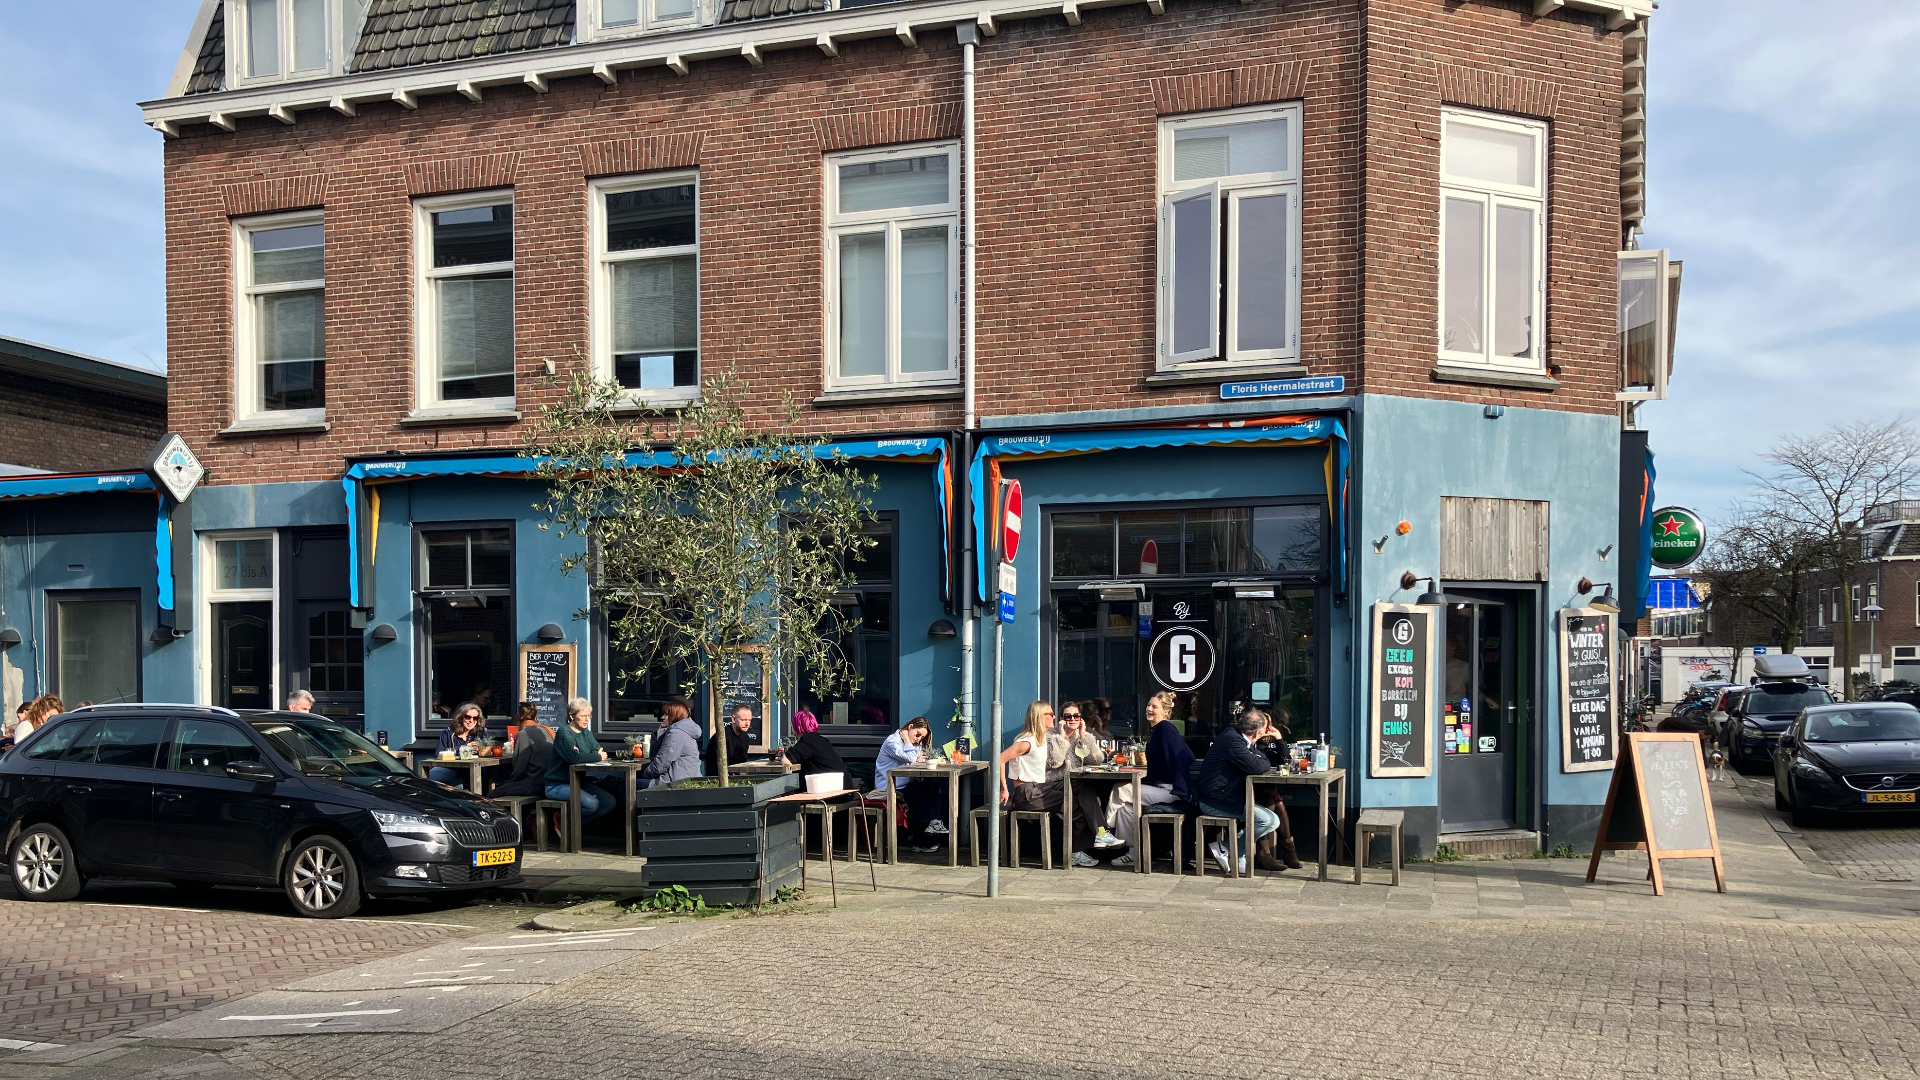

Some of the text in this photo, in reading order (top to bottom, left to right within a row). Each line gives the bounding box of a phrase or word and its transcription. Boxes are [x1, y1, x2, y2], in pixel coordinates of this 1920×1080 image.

[1231, 379, 1335, 394] Floris Heermalestraat
[877, 440, 916, 448] BROUWERIJ
[998, 436, 1038, 446] BROUWERIJ
[1652, 538, 1697, 548] eineken
[224, 565, 268, 579] 27 bis A
[1397, 622, 1409, 641] G
[1570, 633, 1604, 648] WINTER
[529, 652, 564, 662] BIER OP TAP
[1169, 634, 1196, 683] G
[1385, 648, 1414, 663] GEEN
[1394, 676, 1414, 689] KOM
[1381, 689, 1418, 702] BORRELEN
[1394, 703, 1408, 721] BIJ
[1571, 700, 1606, 713] ELKE DAG
[1579, 713, 1597, 724] OPEN
[1382, 721, 1412, 736] GUUS!
[1573, 725, 1601, 736] VANAF
[480, 850, 513, 864] TK-522-S
